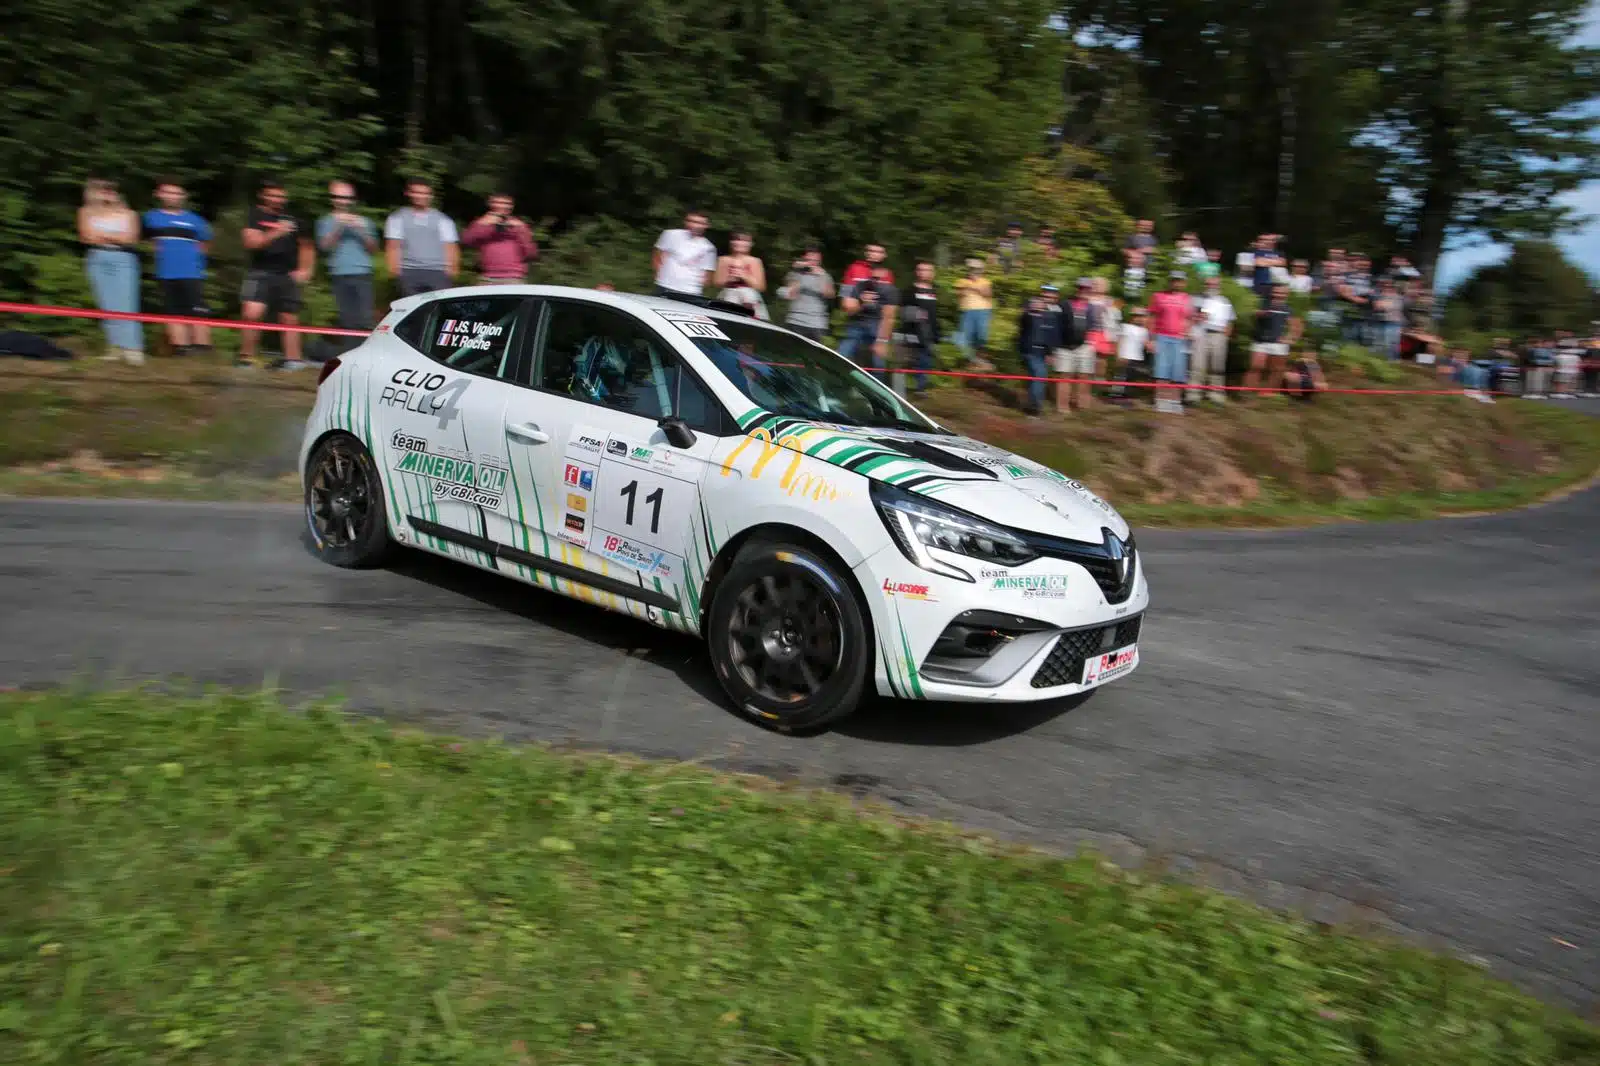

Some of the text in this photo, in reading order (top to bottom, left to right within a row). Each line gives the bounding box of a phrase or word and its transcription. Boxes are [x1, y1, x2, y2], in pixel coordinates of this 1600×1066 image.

[454, 321, 503, 336] JS. Vigion
[451, 335, 491, 350] Y. Roche
[391, 369, 446, 391] CLIO
[378, 377, 473, 430] RALLY 4
[392, 432, 427, 452] team
[579, 436, 602, 447] FFSA
[399, 451, 474, 486] MINERVA
[478, 466, 507, 491] OIL
[434, 482, 500, 507] by GBI.com
[620, 480, 664, 534] 11
[981, 569, 1008, 578] team
[993, 577, 1048, 588] MINERVA
